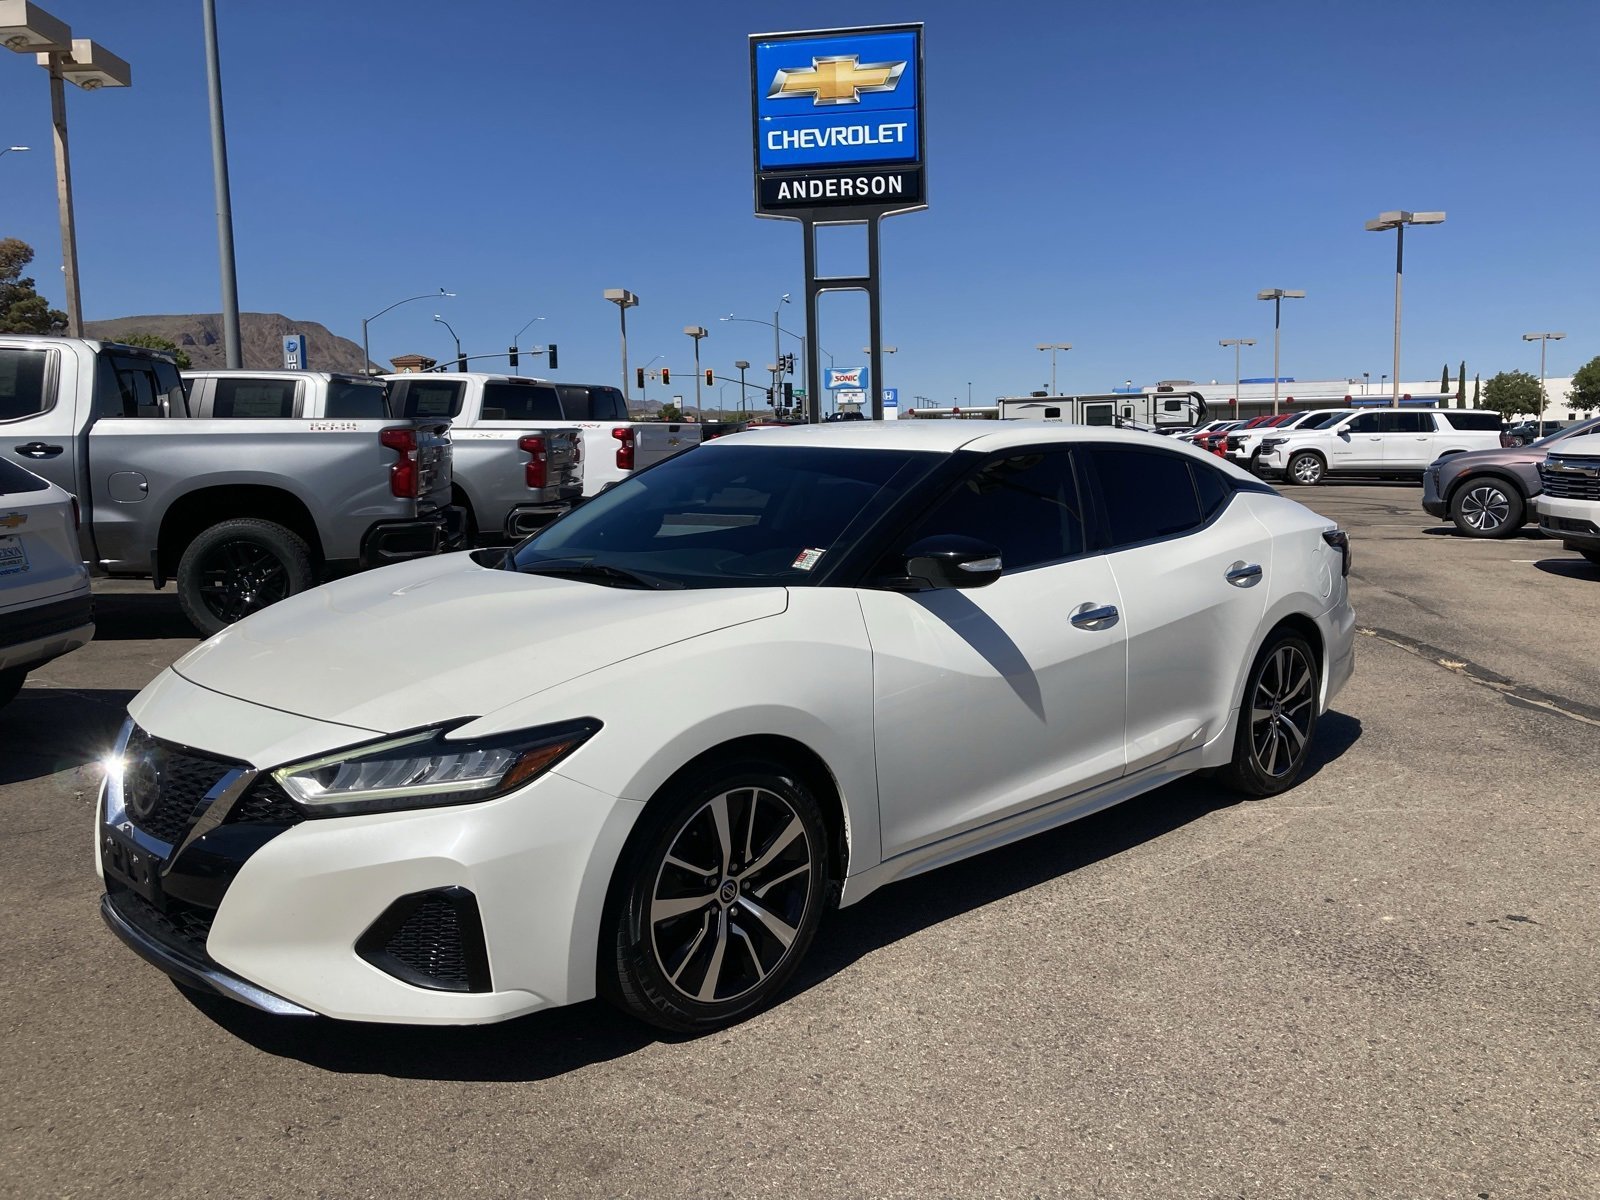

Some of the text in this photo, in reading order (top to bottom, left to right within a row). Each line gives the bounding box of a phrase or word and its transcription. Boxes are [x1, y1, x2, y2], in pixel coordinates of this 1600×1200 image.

[767, 122, 908, 150] CHEVROLET
[777, 175, 903, 200] ANDERSON
[834, 374, 858, 382] SONIC
